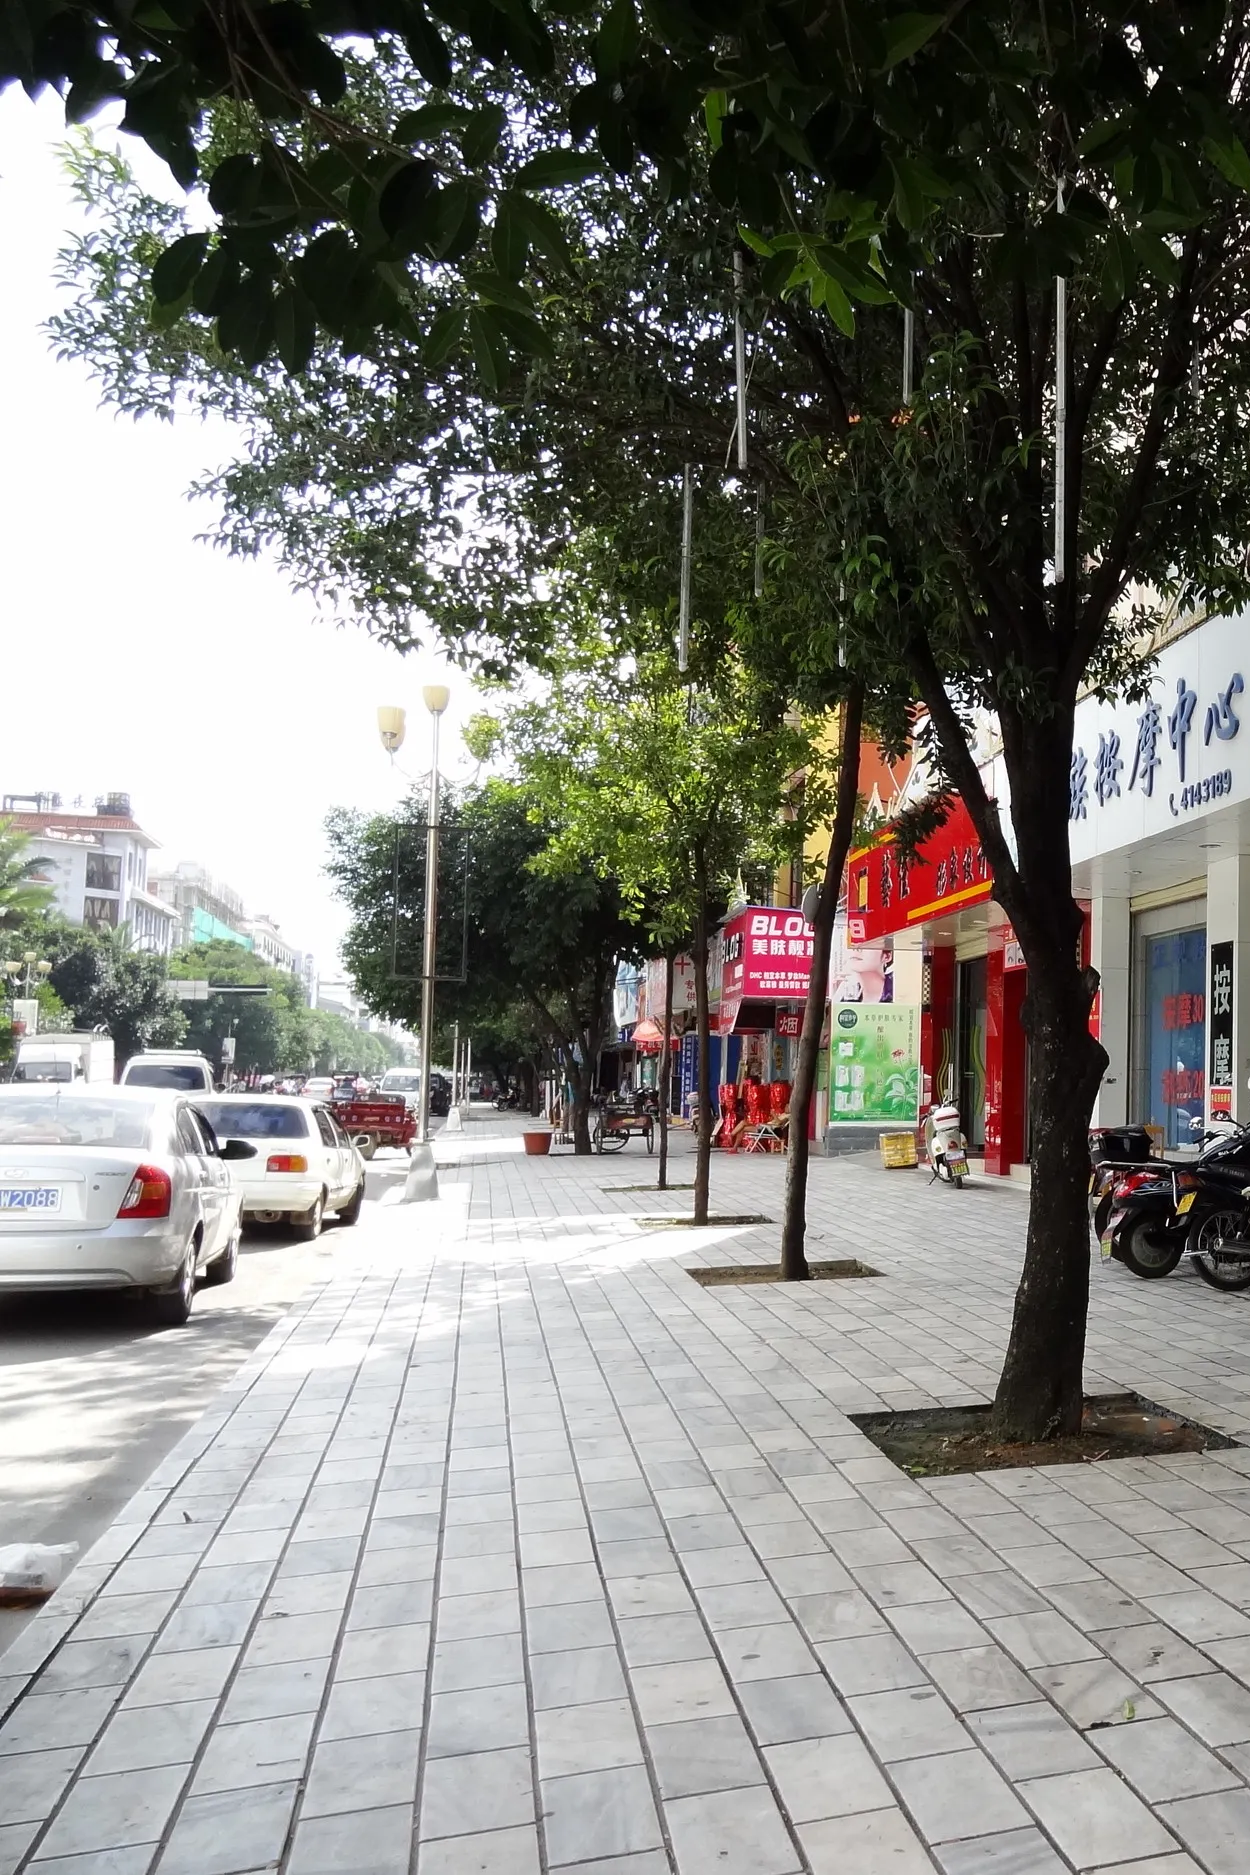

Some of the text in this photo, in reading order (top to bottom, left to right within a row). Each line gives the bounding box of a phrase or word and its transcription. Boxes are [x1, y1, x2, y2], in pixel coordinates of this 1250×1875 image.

[1181, 768, 1232, 811] 4143189
[779, 1016, 799, 1034] 烟
[1213, 963, 1233, 1085] 按摩
